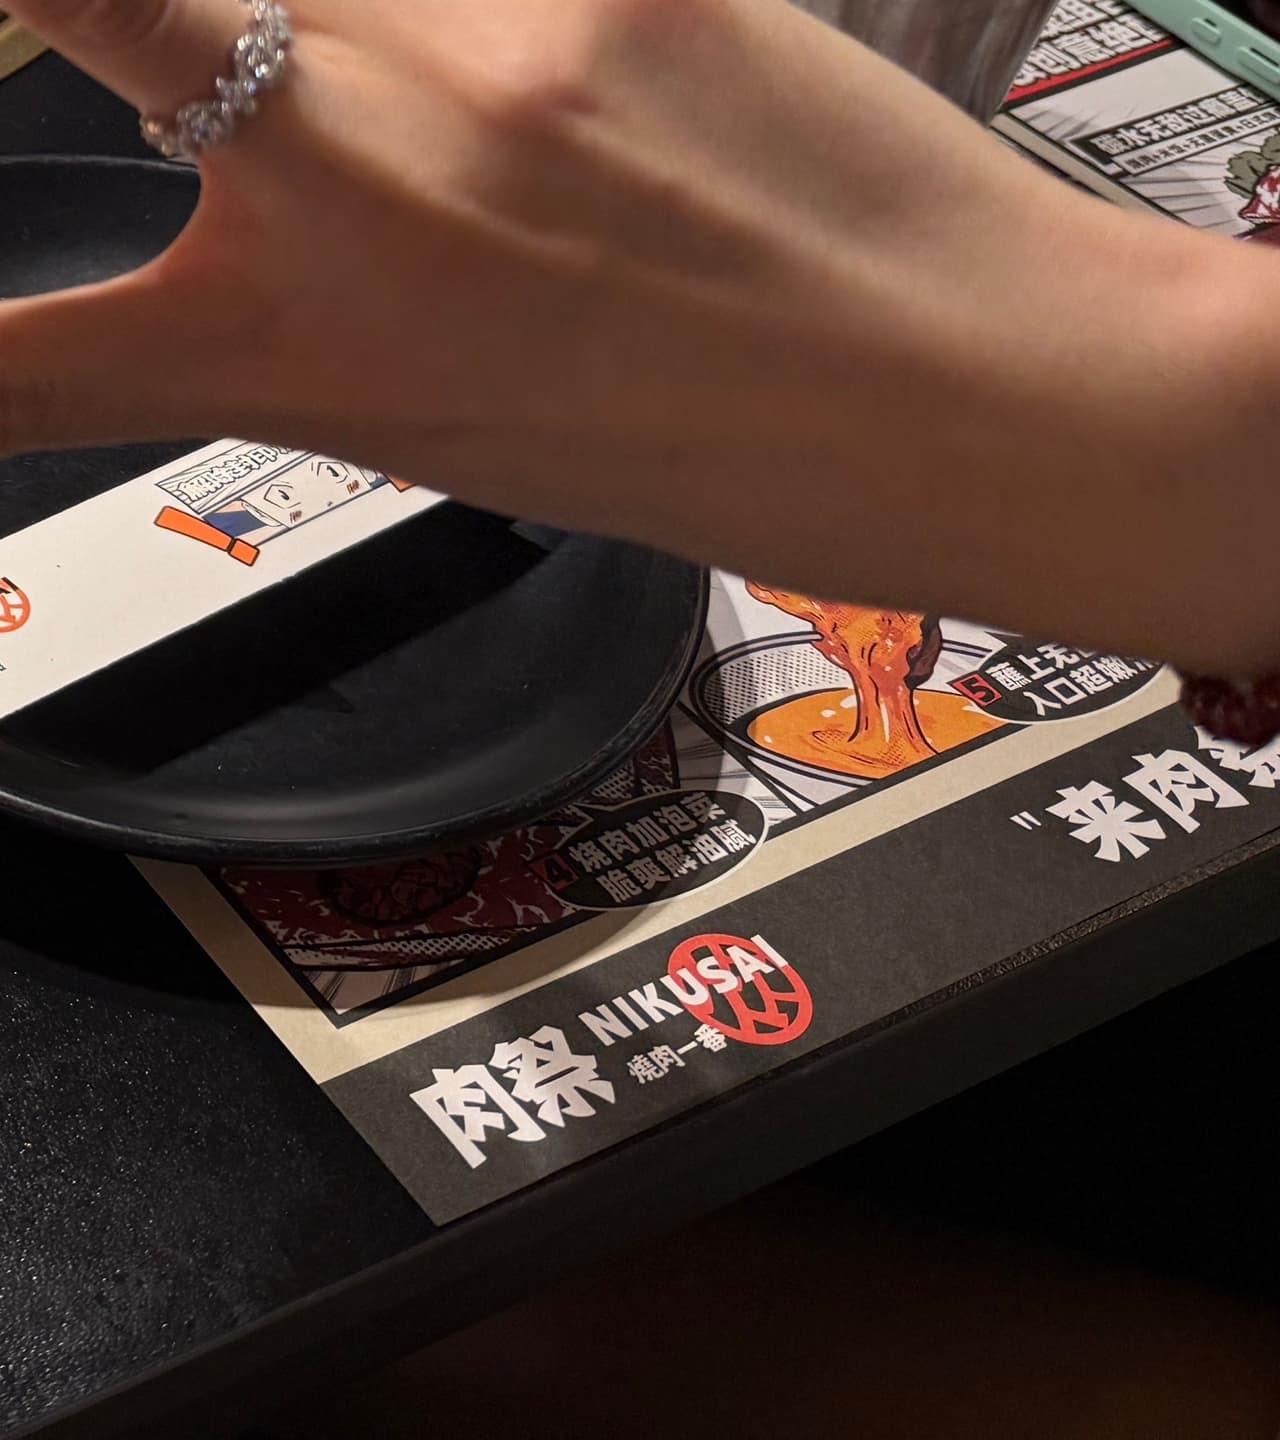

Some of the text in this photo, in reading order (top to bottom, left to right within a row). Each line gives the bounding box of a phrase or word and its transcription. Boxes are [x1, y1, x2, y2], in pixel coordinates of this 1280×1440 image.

[961, 675, 1000, 705] 5
[569, 791, 727, 873] 烧肉加泡菜
[596, 819, 758, 903] 脆爽解油腻
[577, 933, 790, 1047] NIKUSAI
[409, 1024, 615, 1169] 肉祭
